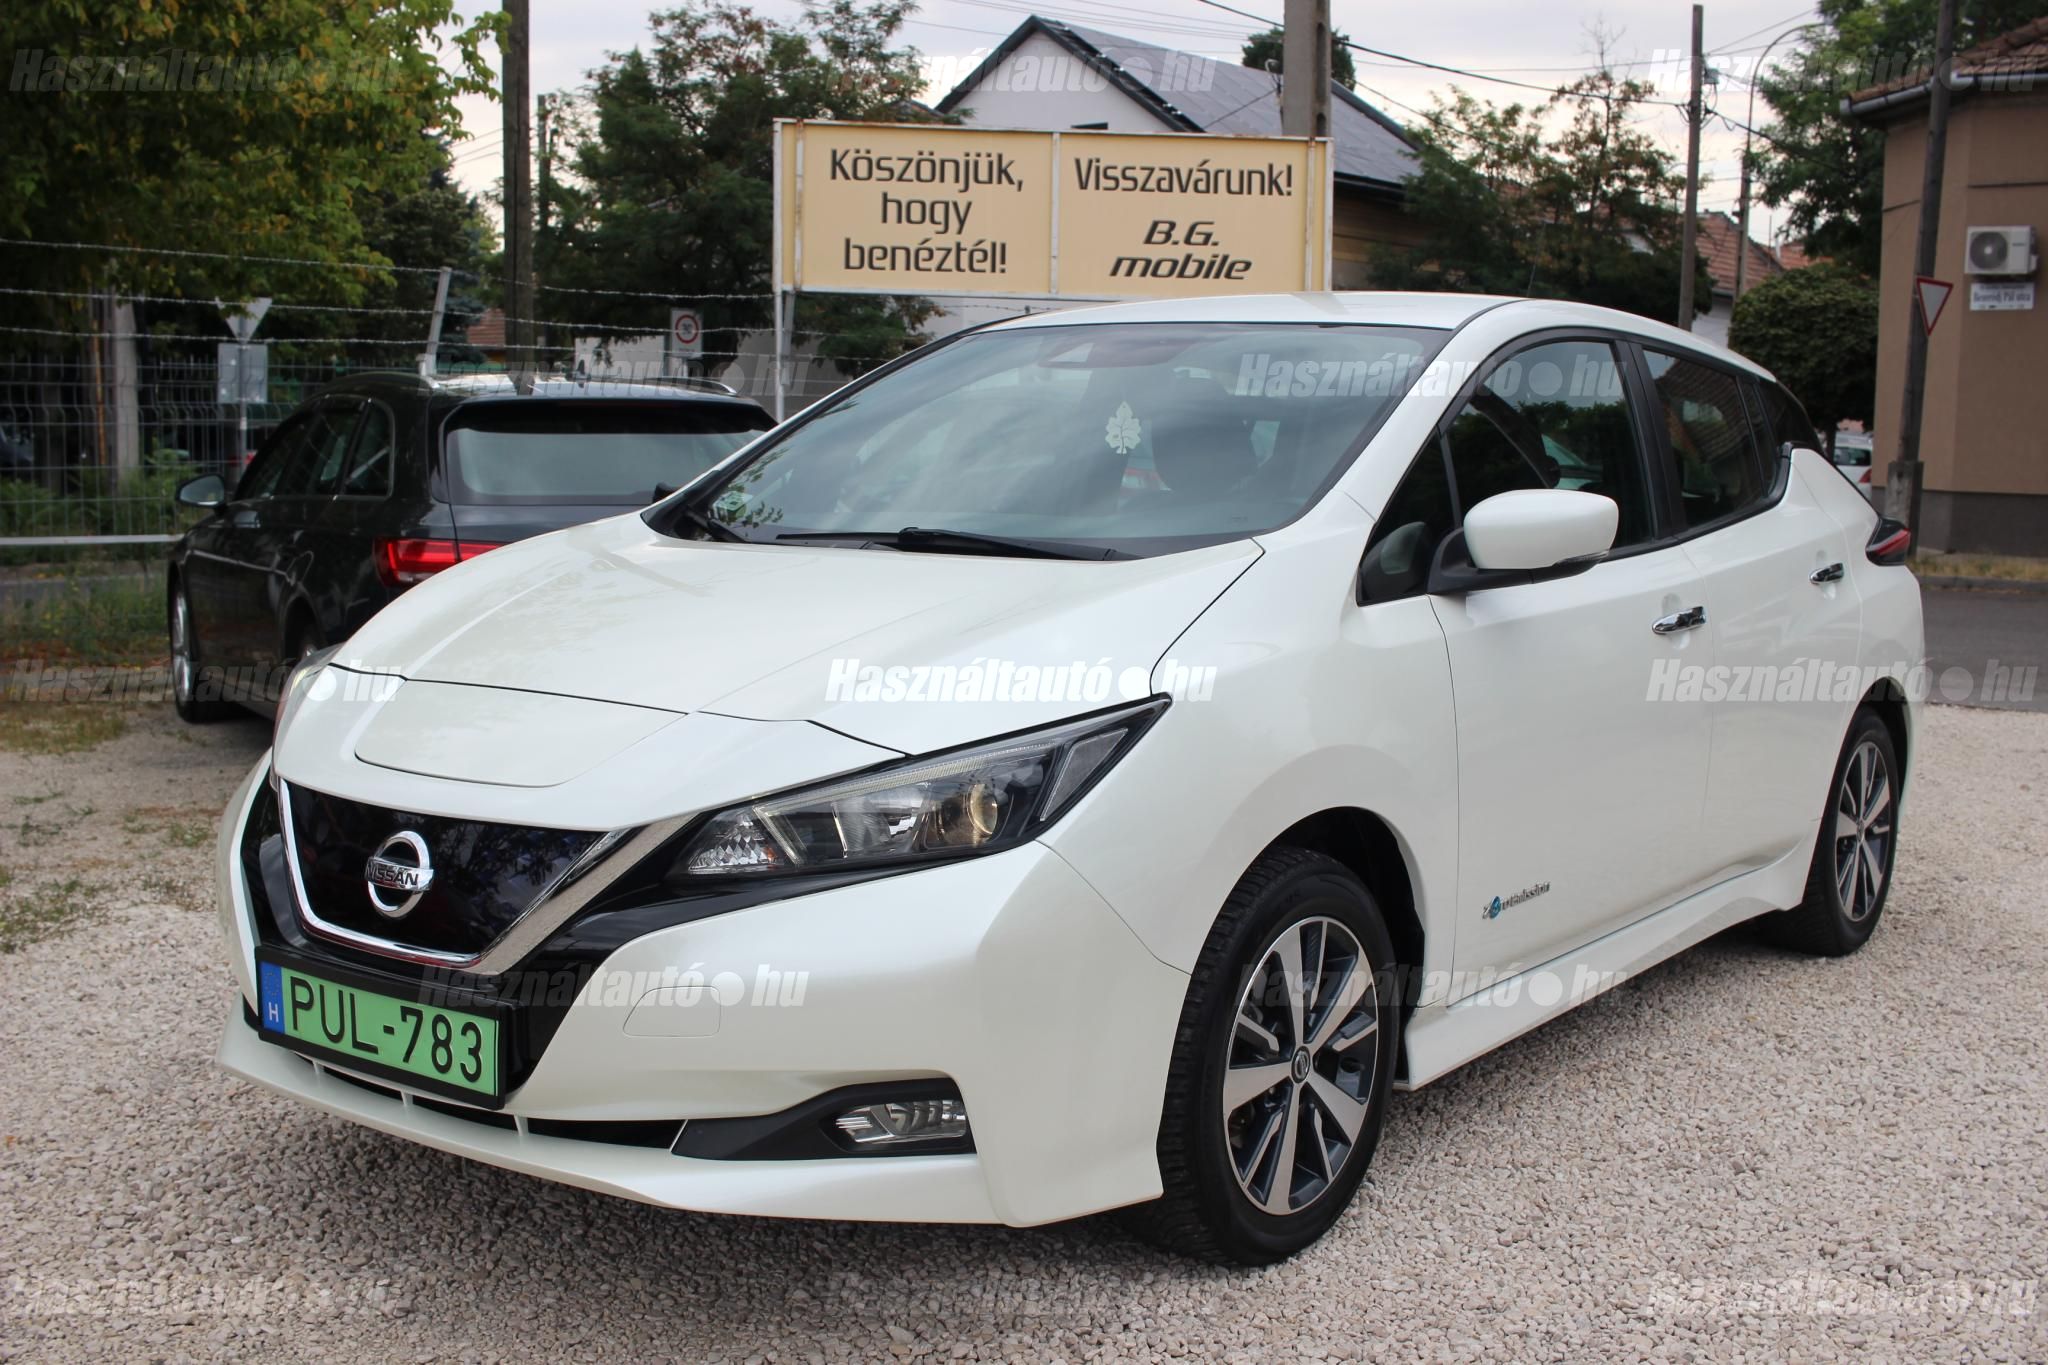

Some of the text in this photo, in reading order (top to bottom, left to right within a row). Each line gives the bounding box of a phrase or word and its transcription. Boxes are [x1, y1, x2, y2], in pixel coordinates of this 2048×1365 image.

[829, 148, 1024, 193] Köszönjük,
[1074, 158, 1293, 197] Visszavárunk!
[881, 191, 973, 235] hogy
[1143, 219, 1220, 247] B.G.
[844, 237, 1007, 274] benéztél!
[1109, 252, 1253, 280] mobile
[365, 857, 419, 886] NISSAN
[268, 1001, 280, 1023] H
[289, 975, 483, 1083] PUL-783
